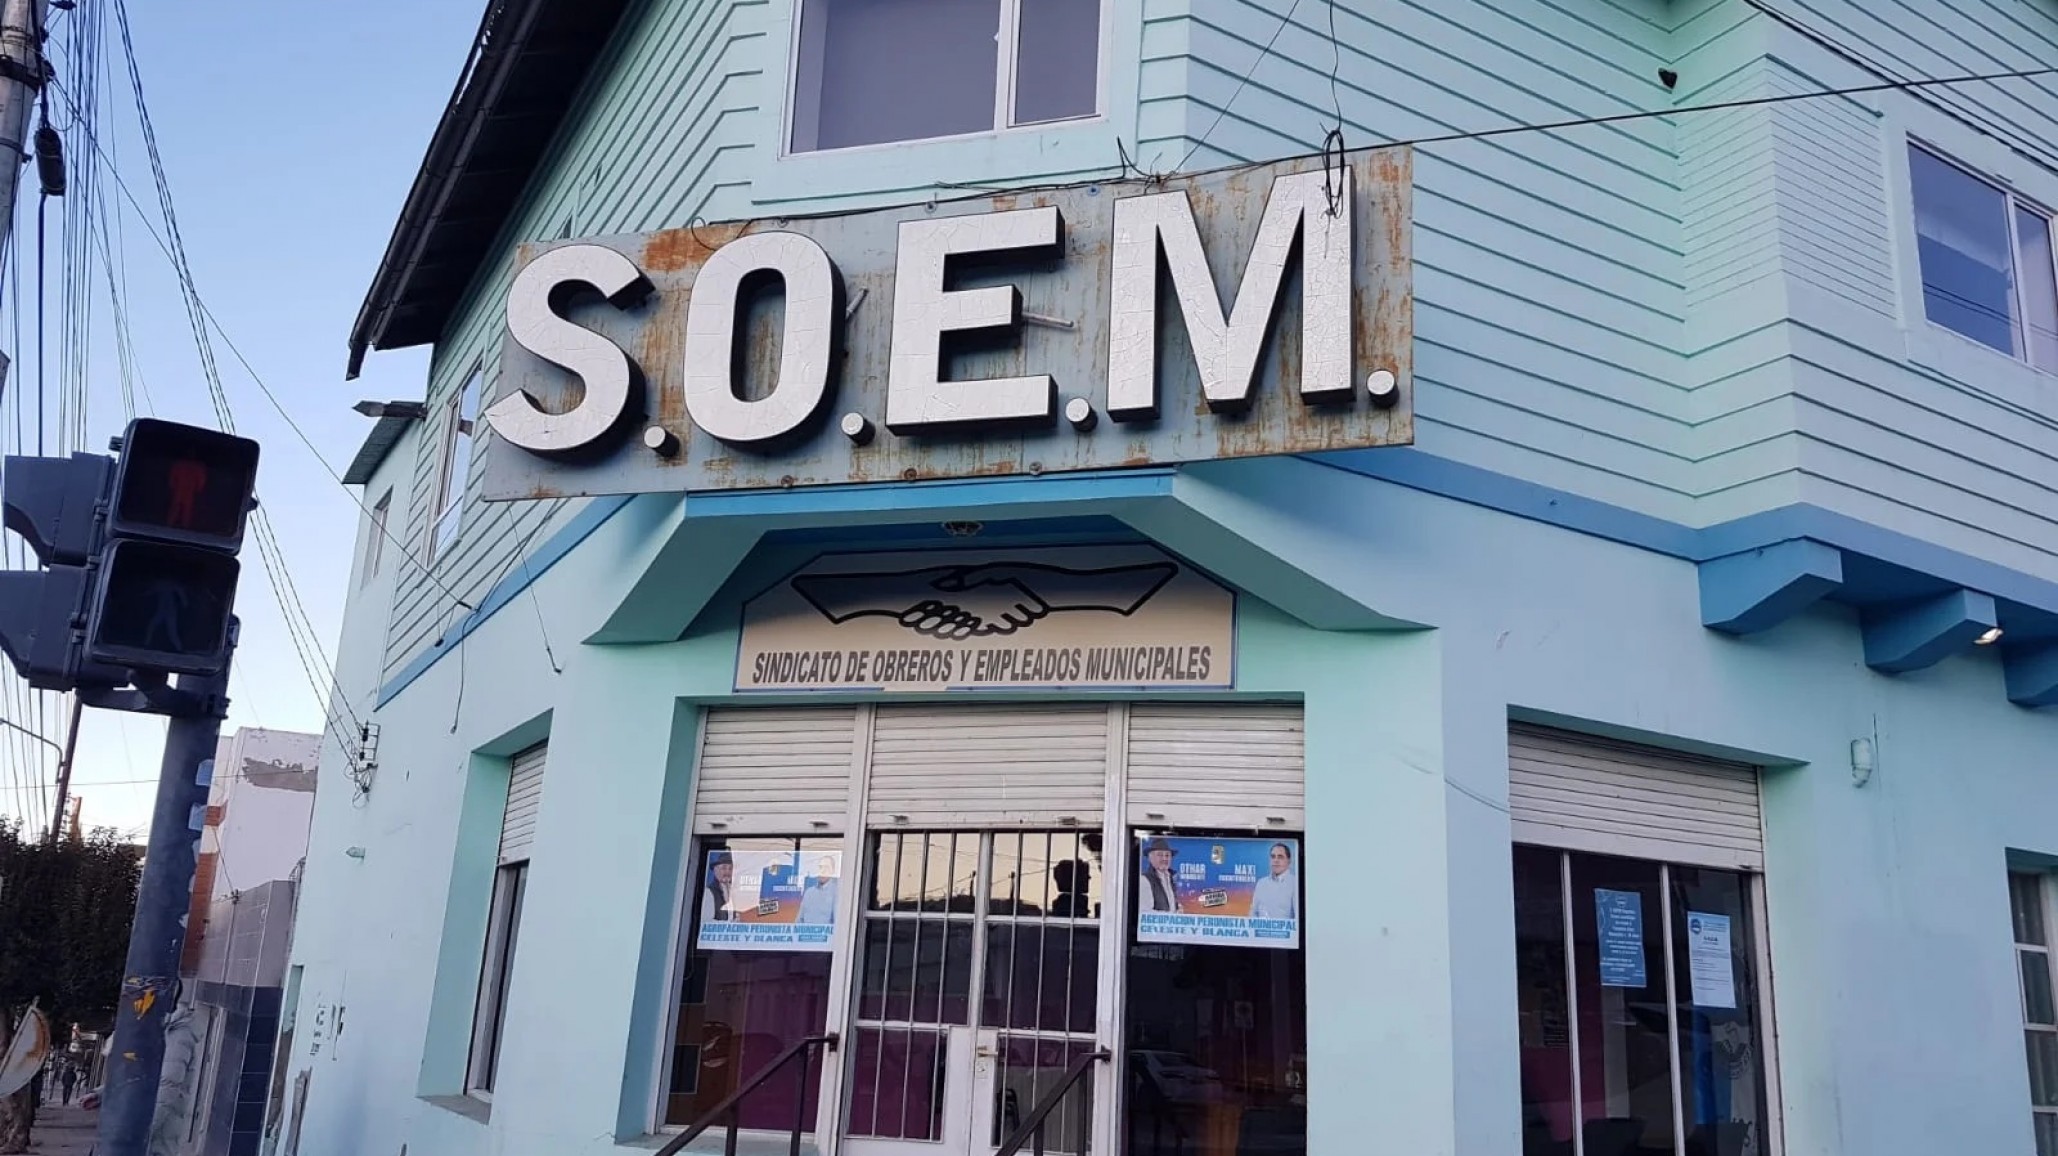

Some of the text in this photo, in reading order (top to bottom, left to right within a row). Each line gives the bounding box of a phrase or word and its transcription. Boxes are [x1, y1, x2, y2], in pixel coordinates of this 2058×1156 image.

[484, 167, 1396, 455] S.O.E.M.
[752, 646, 1212, 683] SINDICATO DE OBREROS Y EMPLEADOS MUNICIPALES
[1234, 864, 1256, 875] MAXI
[1197, 915, 1246, 928] PERONISTA
[1249, 918, 1297, 931] MUNICIPAL
[744, 934, 752, 942] Y
[1140, 926, 1188, 934] CELESTE
[1190, 927, 1199, 935] Y
[1202, 927, 1250, 938] BLANCA
